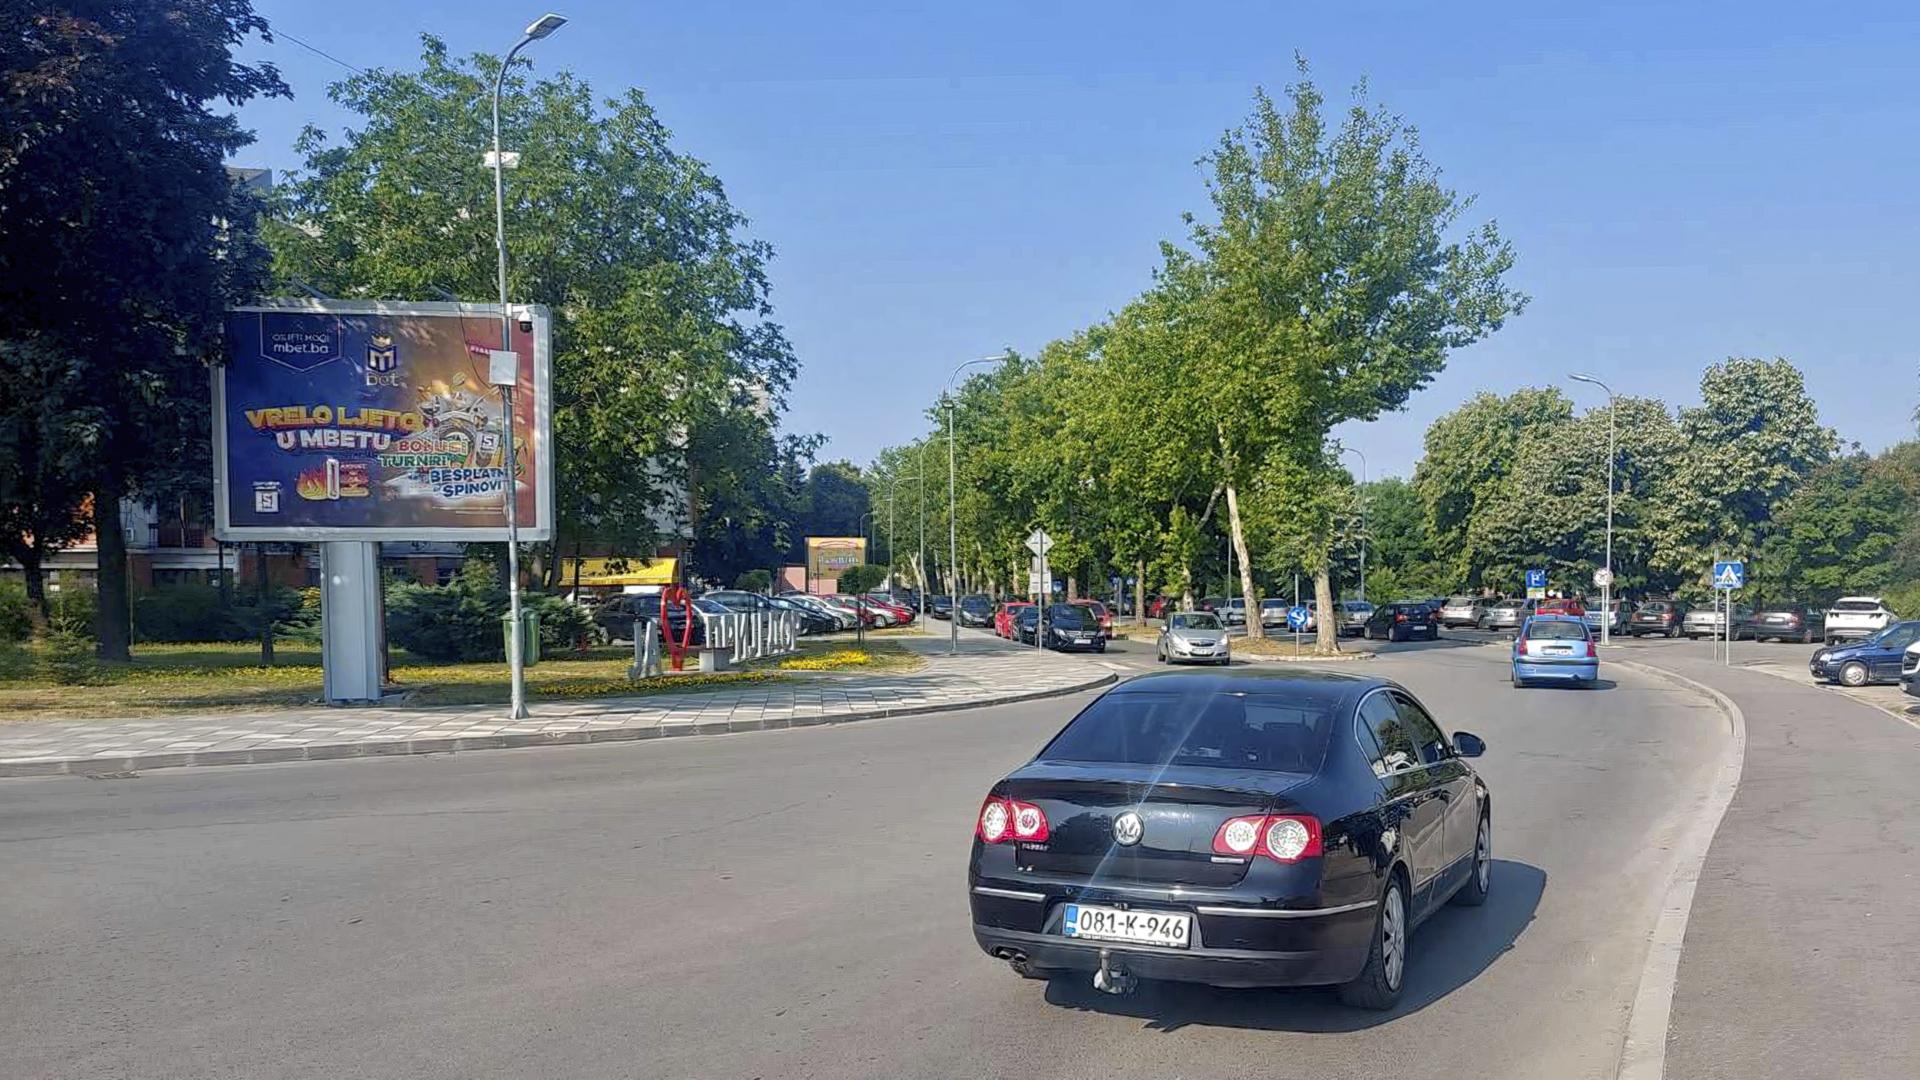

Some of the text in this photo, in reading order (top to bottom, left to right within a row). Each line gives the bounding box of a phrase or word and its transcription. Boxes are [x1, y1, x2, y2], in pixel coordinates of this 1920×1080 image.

[273, 342, 329, 354] mbet.ba
[245, 405, 425, 432] VRELO LJETO
[275, 428, 392, 450] U MBETU
[380, 454, 448, 468] TURNIRI
[430, 468, 508, 483] BESPLATN
[442, 481, 502, 498] SPINOVI
[1080, 909, 1184, 940] 081-K-946
